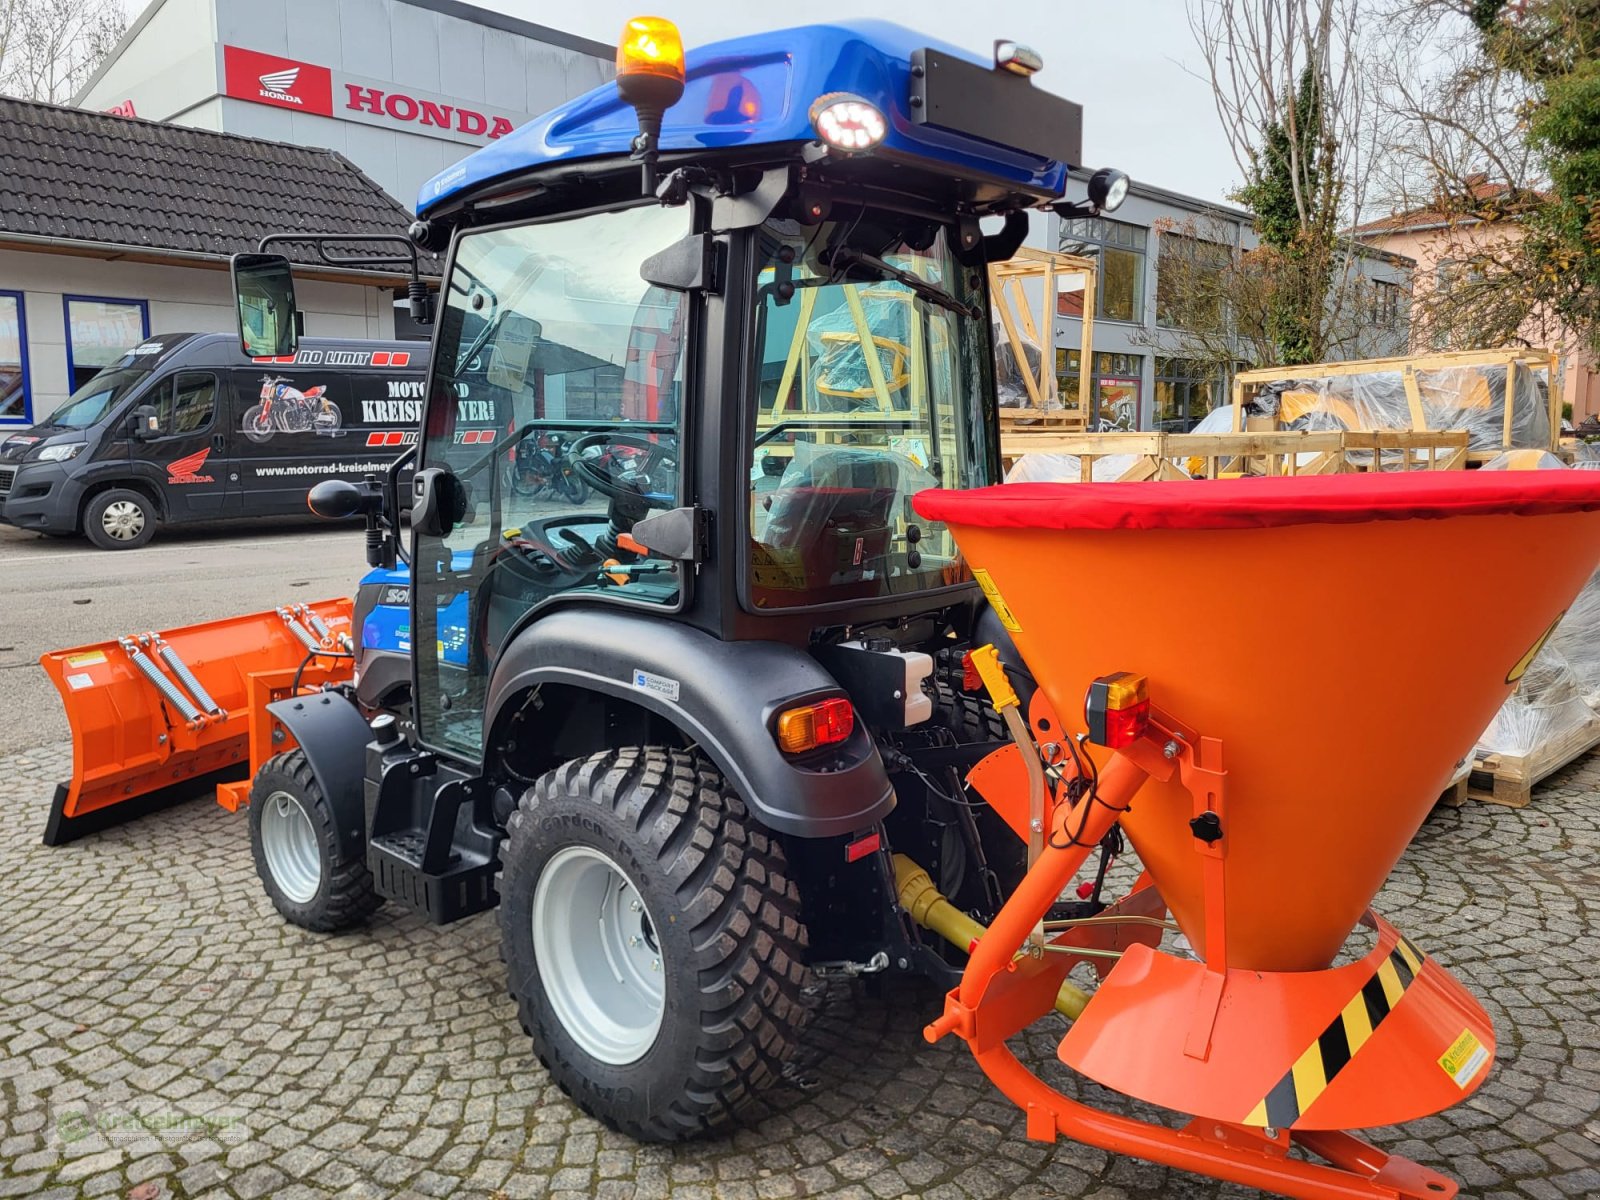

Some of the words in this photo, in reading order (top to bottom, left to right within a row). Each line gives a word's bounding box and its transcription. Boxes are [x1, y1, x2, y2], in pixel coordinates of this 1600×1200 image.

[258, 89, 303, 104] HONDA
[345, 84, 515, 139] HONDA
[168, 475, 215, 484] HONDA
